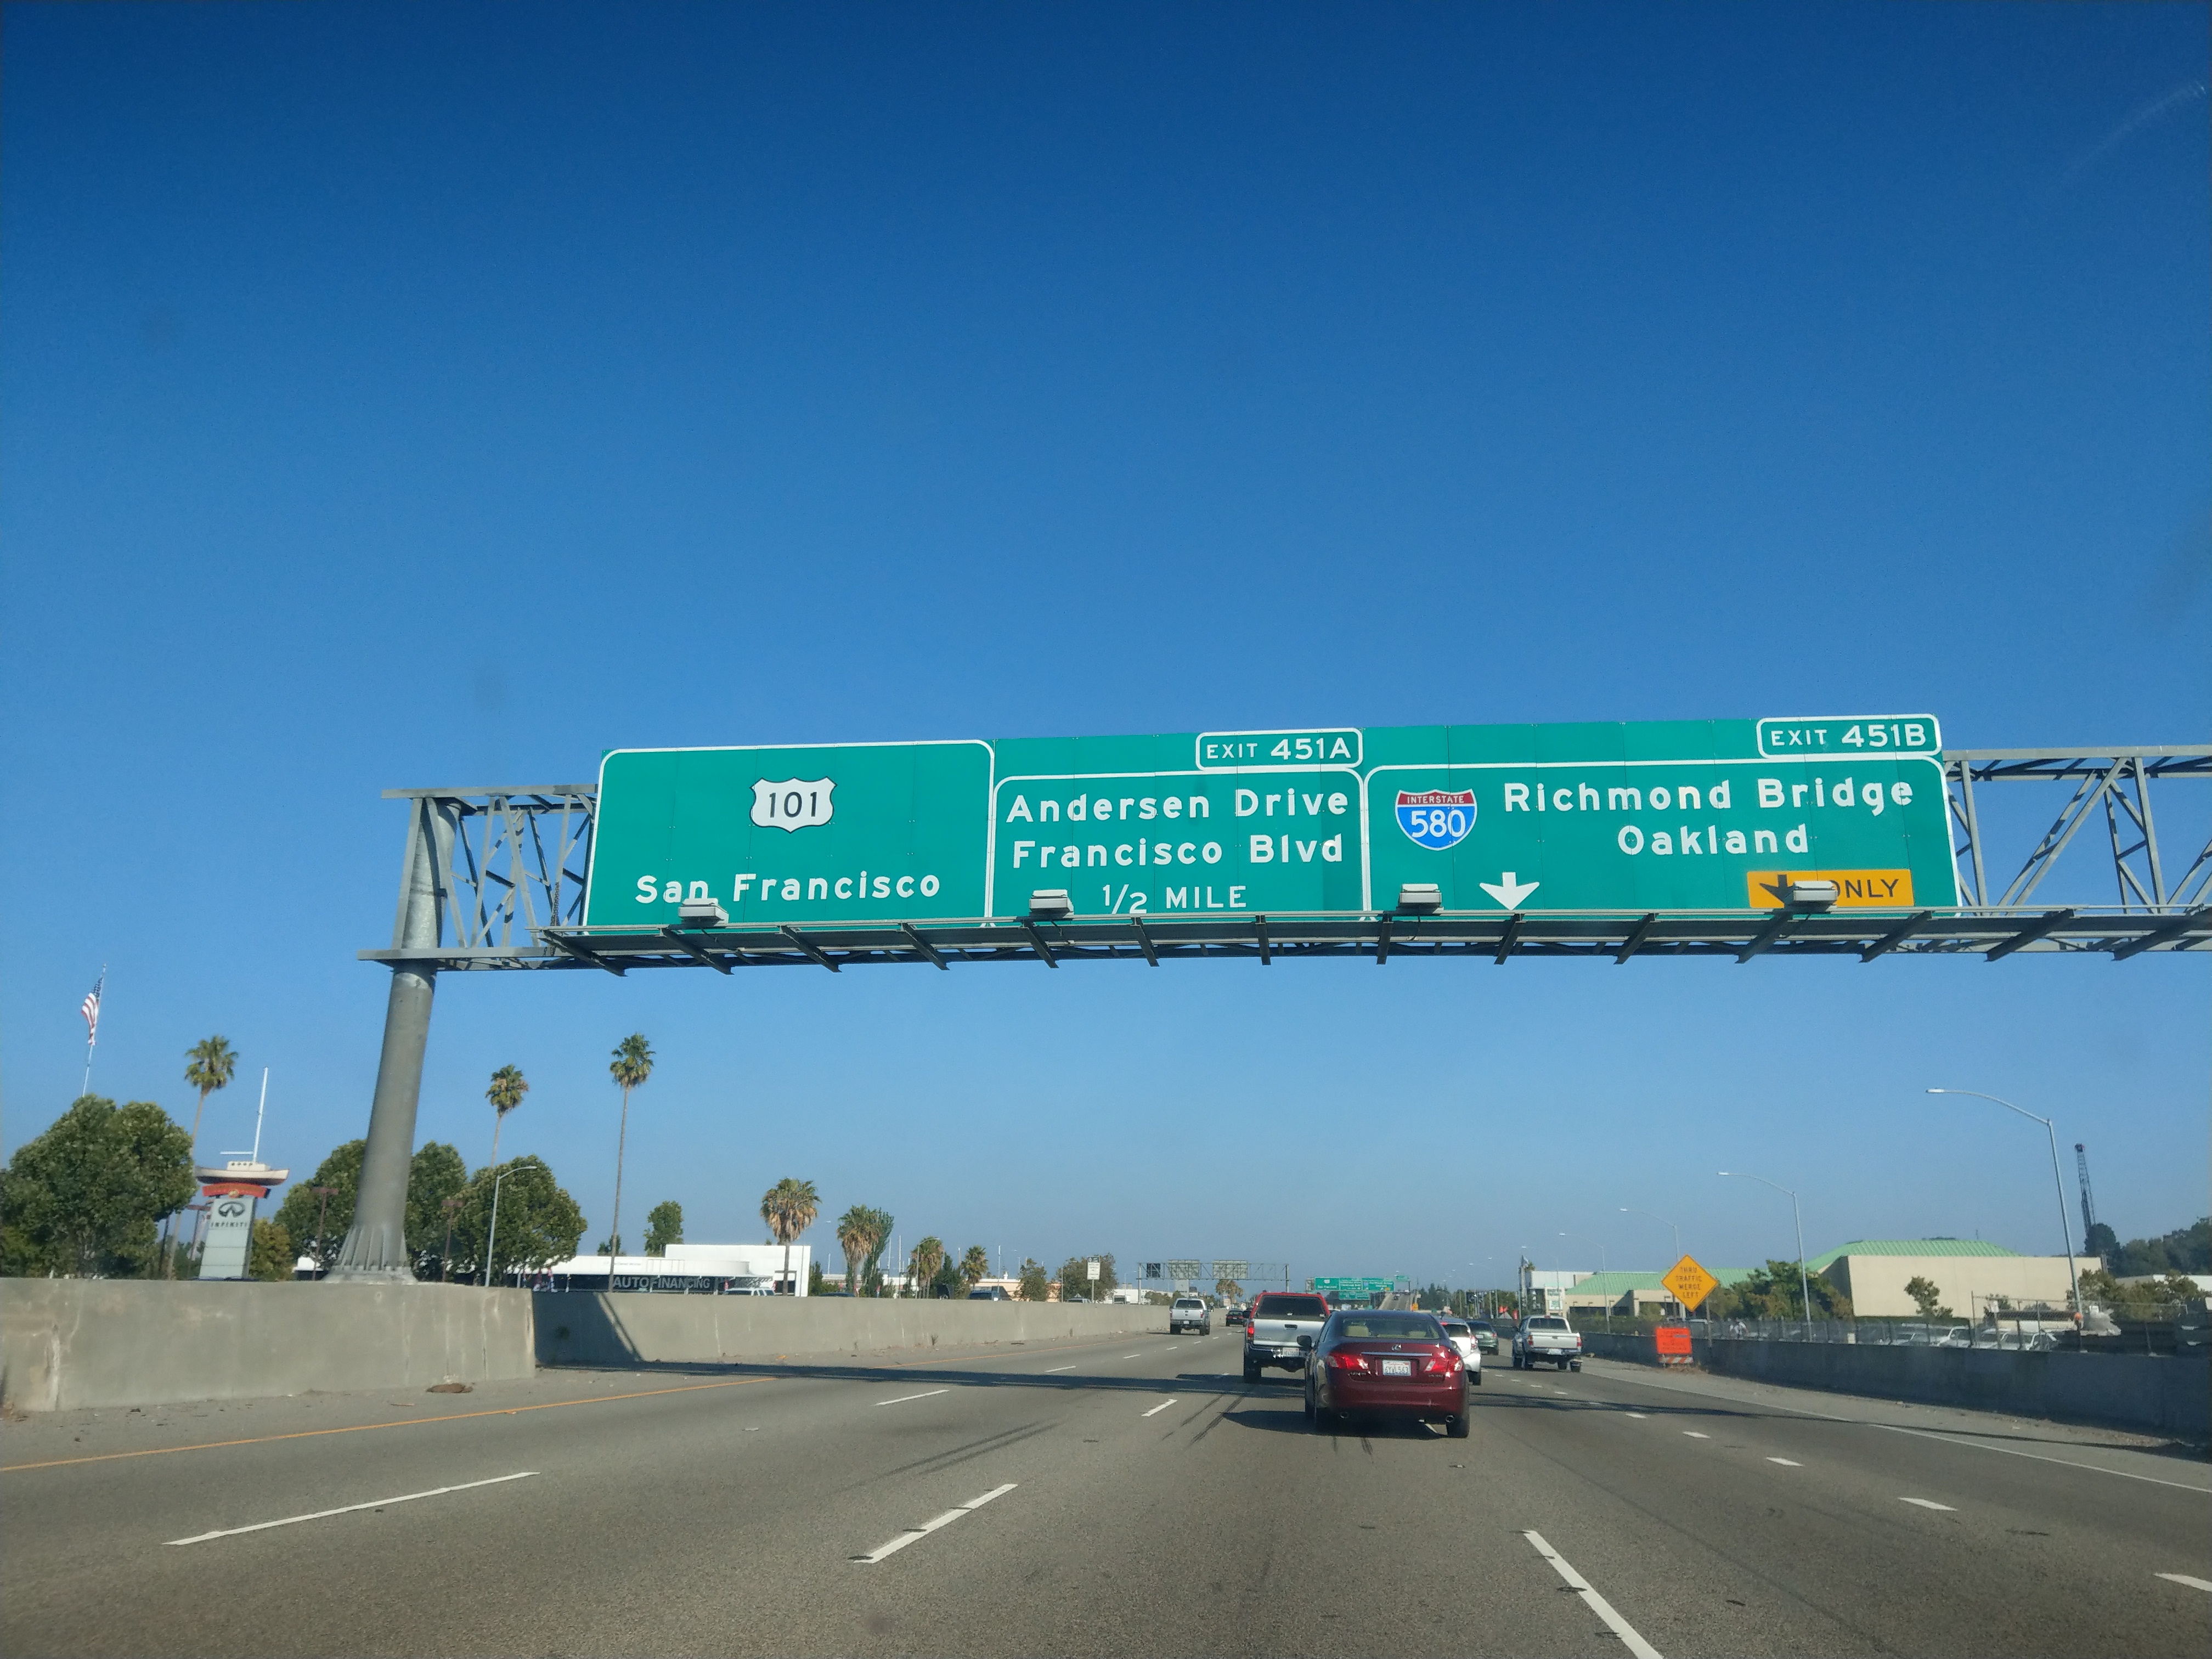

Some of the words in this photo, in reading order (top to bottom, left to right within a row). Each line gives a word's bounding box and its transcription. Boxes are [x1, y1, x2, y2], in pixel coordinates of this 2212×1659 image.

[1207, 743, 1258, 759] EXIT
[1271, 737, 1351, 759] 451A
[1771, 730, 1827, 746] EXIT
[1841, 724, 1926, 747] 451B
[769, 792, 817, 817] 101
[1006, 793, 1209, 823] Andersen
[1235, 788, 1348, 817] Drive
[1407, 795, 1464, 804] INTERSTATE
[1504, 780, 1731, 812] Richmond
[1757, 777, 1913, 816] Bridge
[1411, 810, 1466, 838] 580
[1618, 823, 1808, 855] Oakland
[1013, 838, 1222, 868] Francisco
[1250, 833, 1342, 863] Blvd
[635, 875, 708, 904] San
[733, 871, 940, 902] Francisco
[1103, 884, 1147, 914] 1/2
[1166, 885, 1246, 909] MILE
